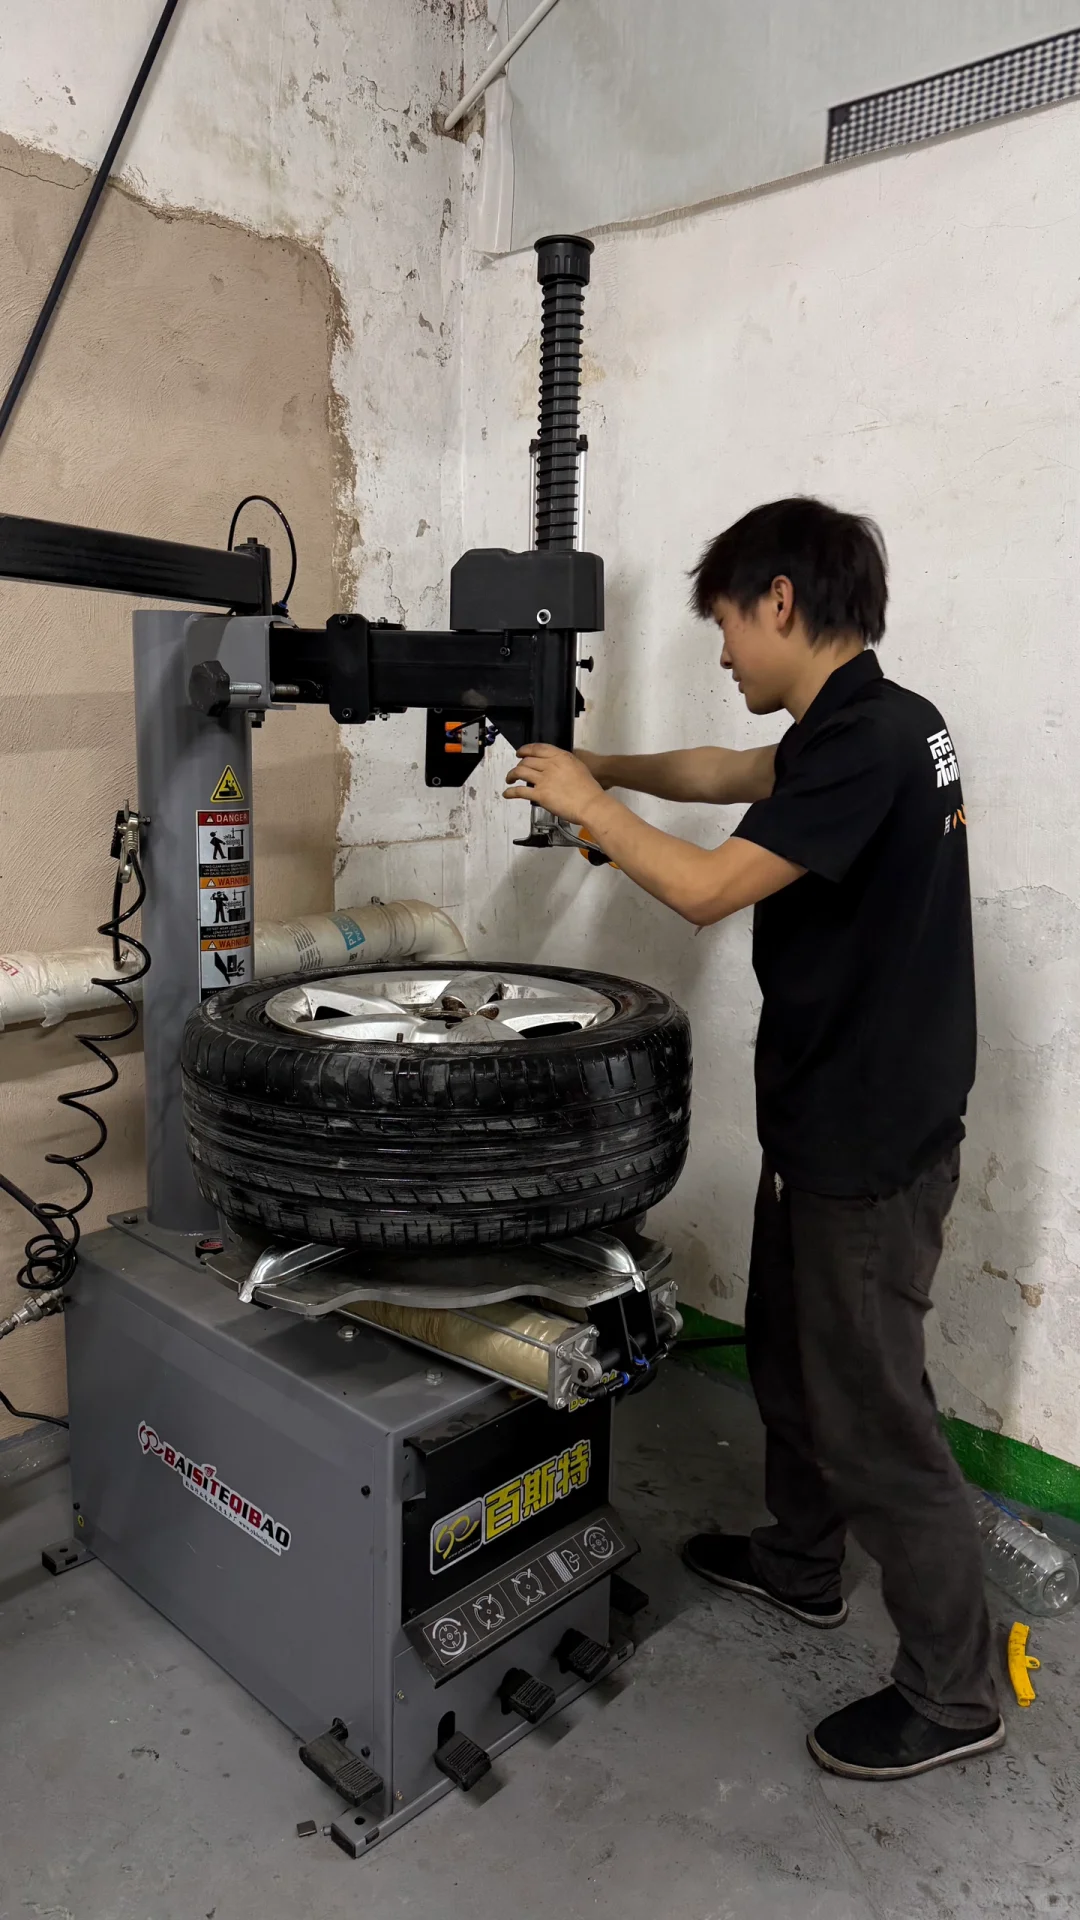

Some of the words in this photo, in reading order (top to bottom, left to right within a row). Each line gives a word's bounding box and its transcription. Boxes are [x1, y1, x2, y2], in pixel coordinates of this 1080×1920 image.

[216, 813, 247, 823] DANGER
[217, 876, 249, 886] WARNING
[219, 937, 249, 948] WARNING
[486, 1441, 589, 1541] 百斯特
